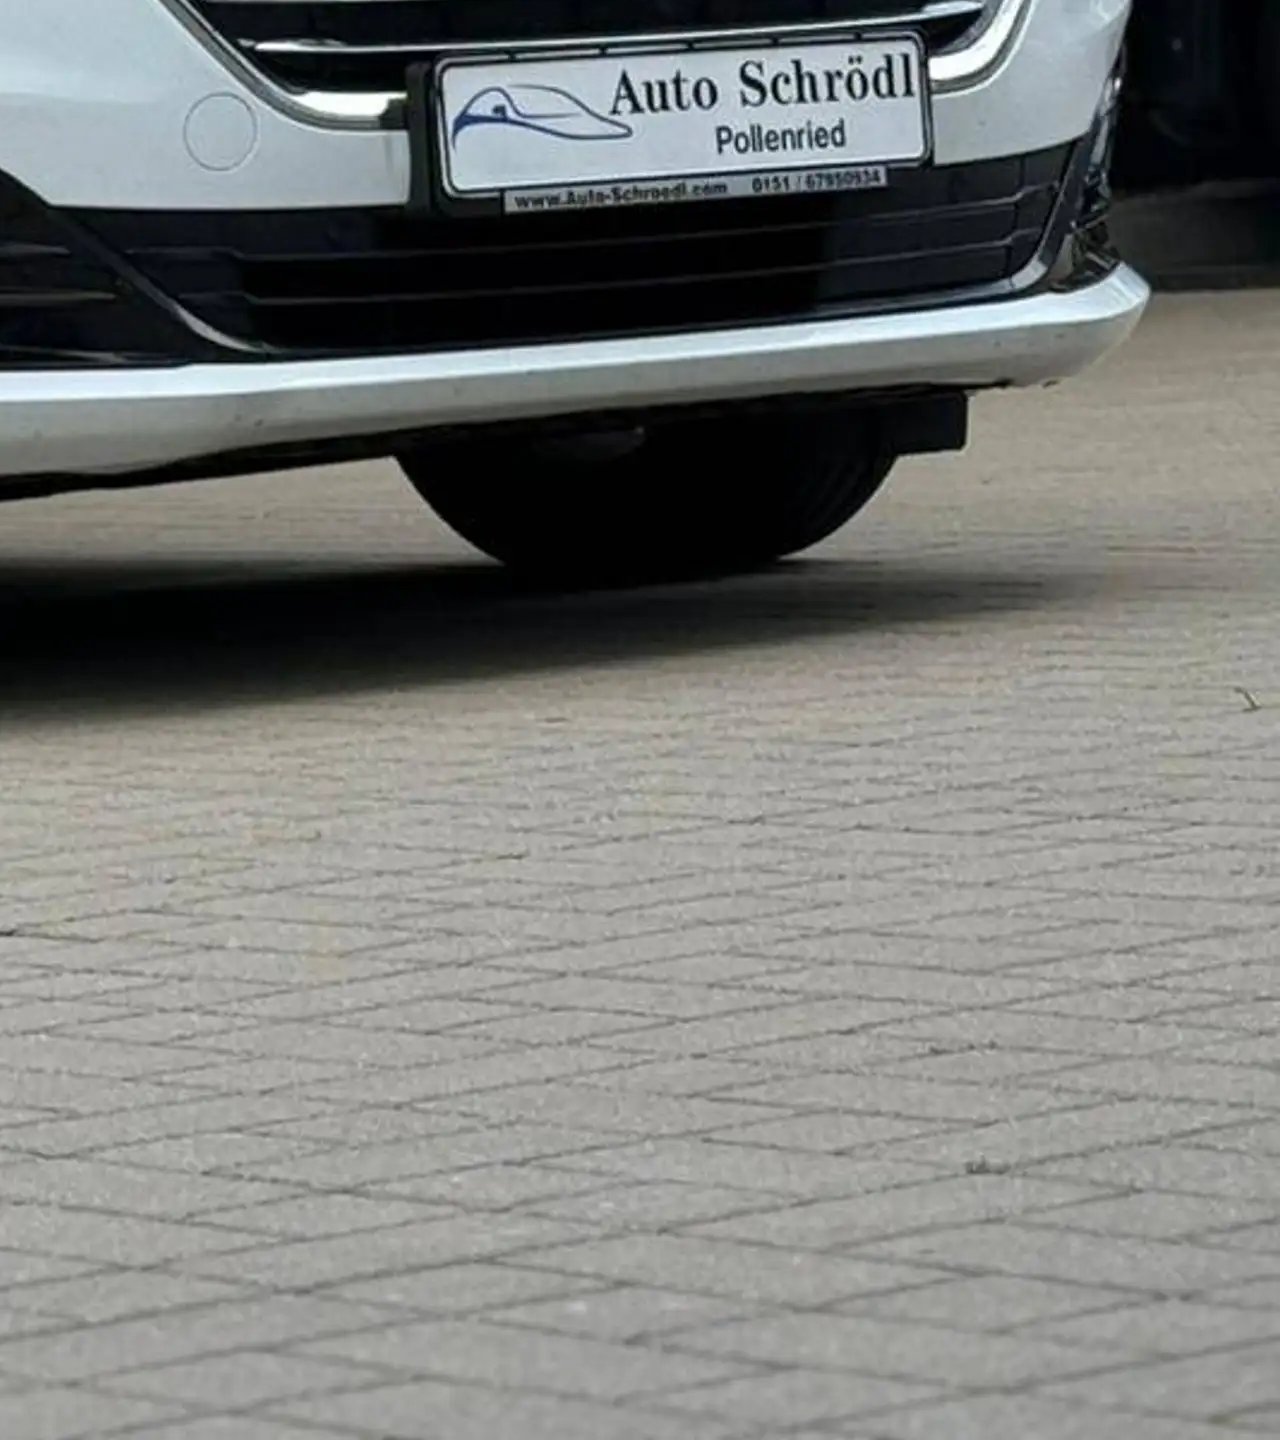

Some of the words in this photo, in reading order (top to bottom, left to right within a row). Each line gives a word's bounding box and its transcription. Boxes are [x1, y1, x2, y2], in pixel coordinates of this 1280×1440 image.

[609, 68, 718, 116] Auto
[740, 52, 915, 107] Schrödl
[715, 119, 847, 155] Pollenried
